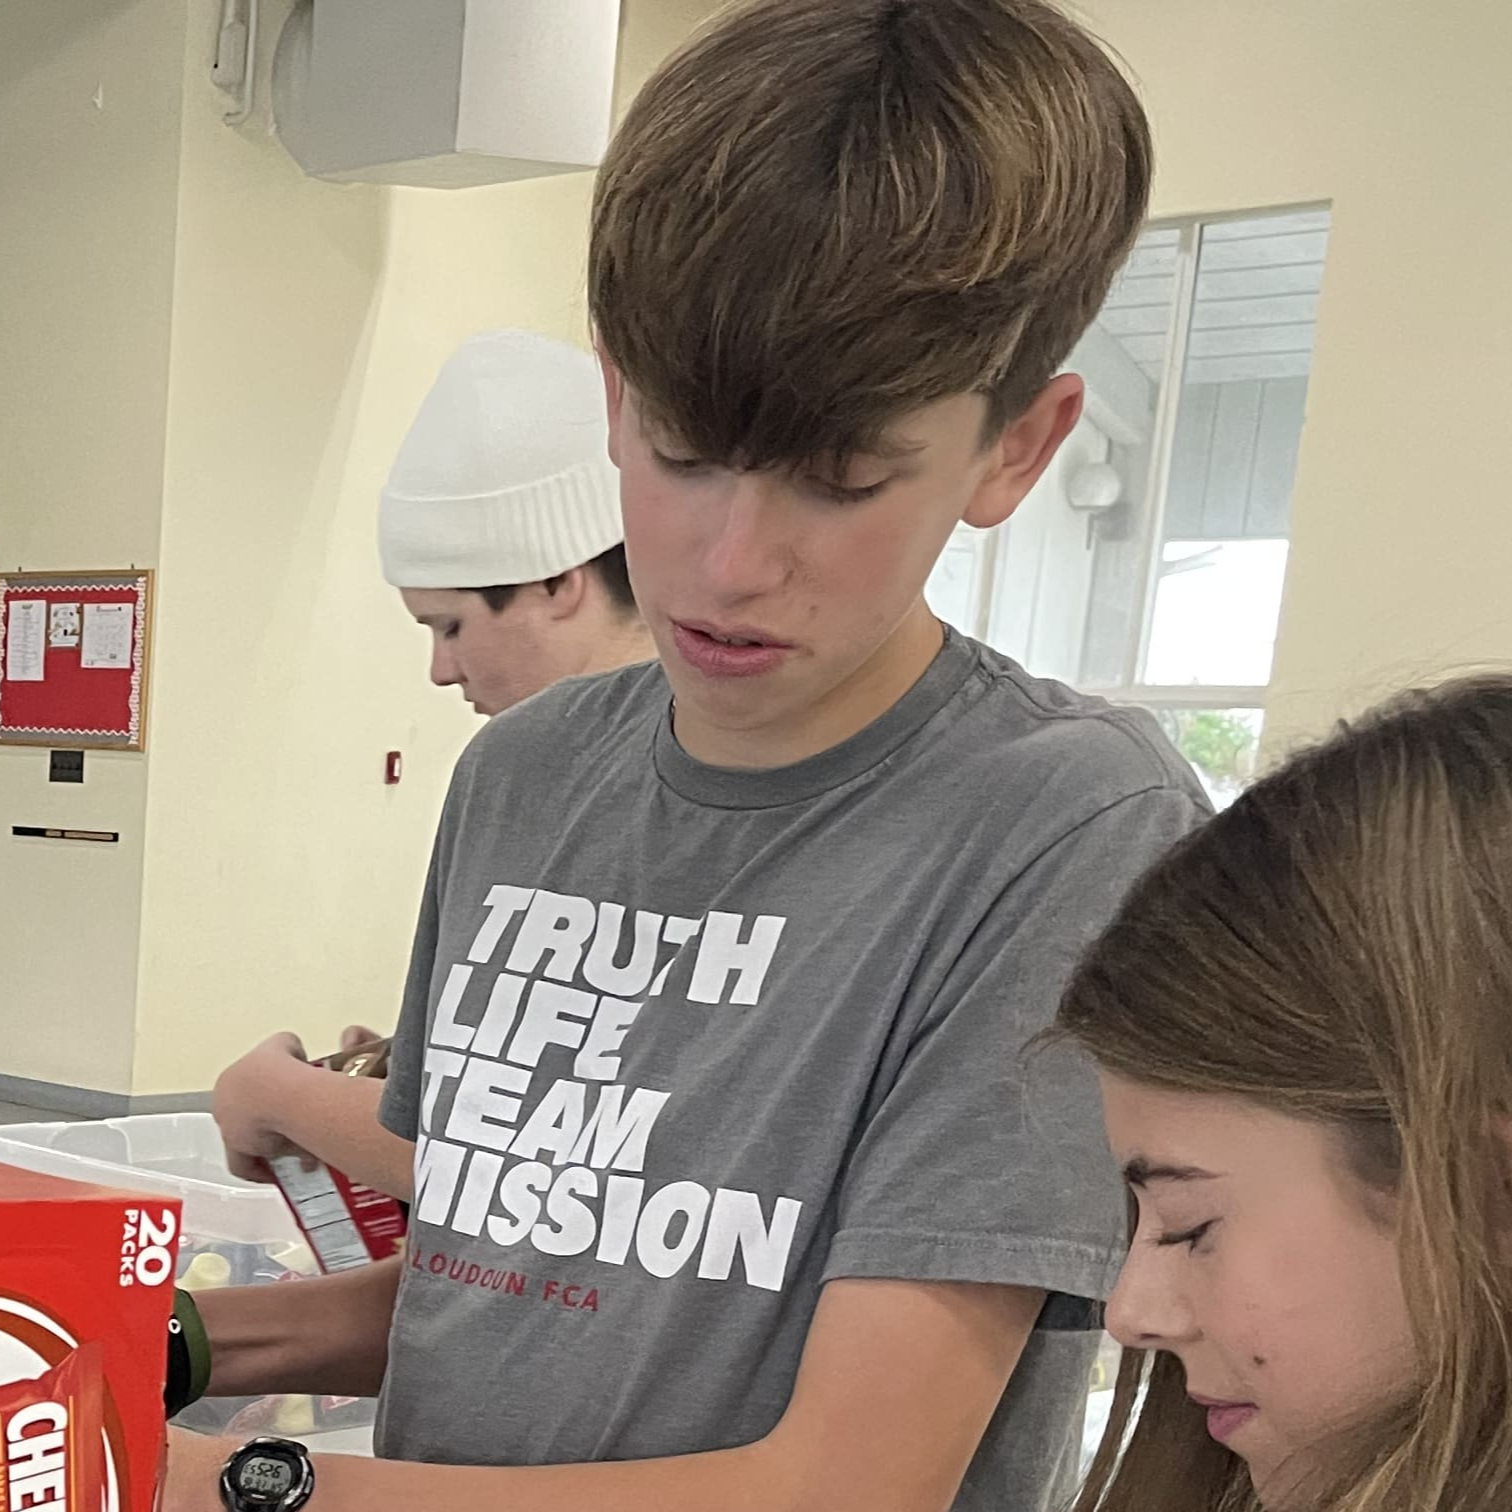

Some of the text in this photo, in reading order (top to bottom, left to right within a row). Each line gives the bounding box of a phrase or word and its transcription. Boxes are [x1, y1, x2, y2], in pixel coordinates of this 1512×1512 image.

[466, 884, 787, 1006] TRUTH
[430, 964, 645, 1081] LIFE
[422, 1048, 673, 1172] TEAM
[120, 1209, 139, 1288] PACKS
[134, 1210, 177, 1288] 20
[414, 1134, 803, 1292] MISSION
[411, 1249, 601, 1313] LOUDOUN FCA
